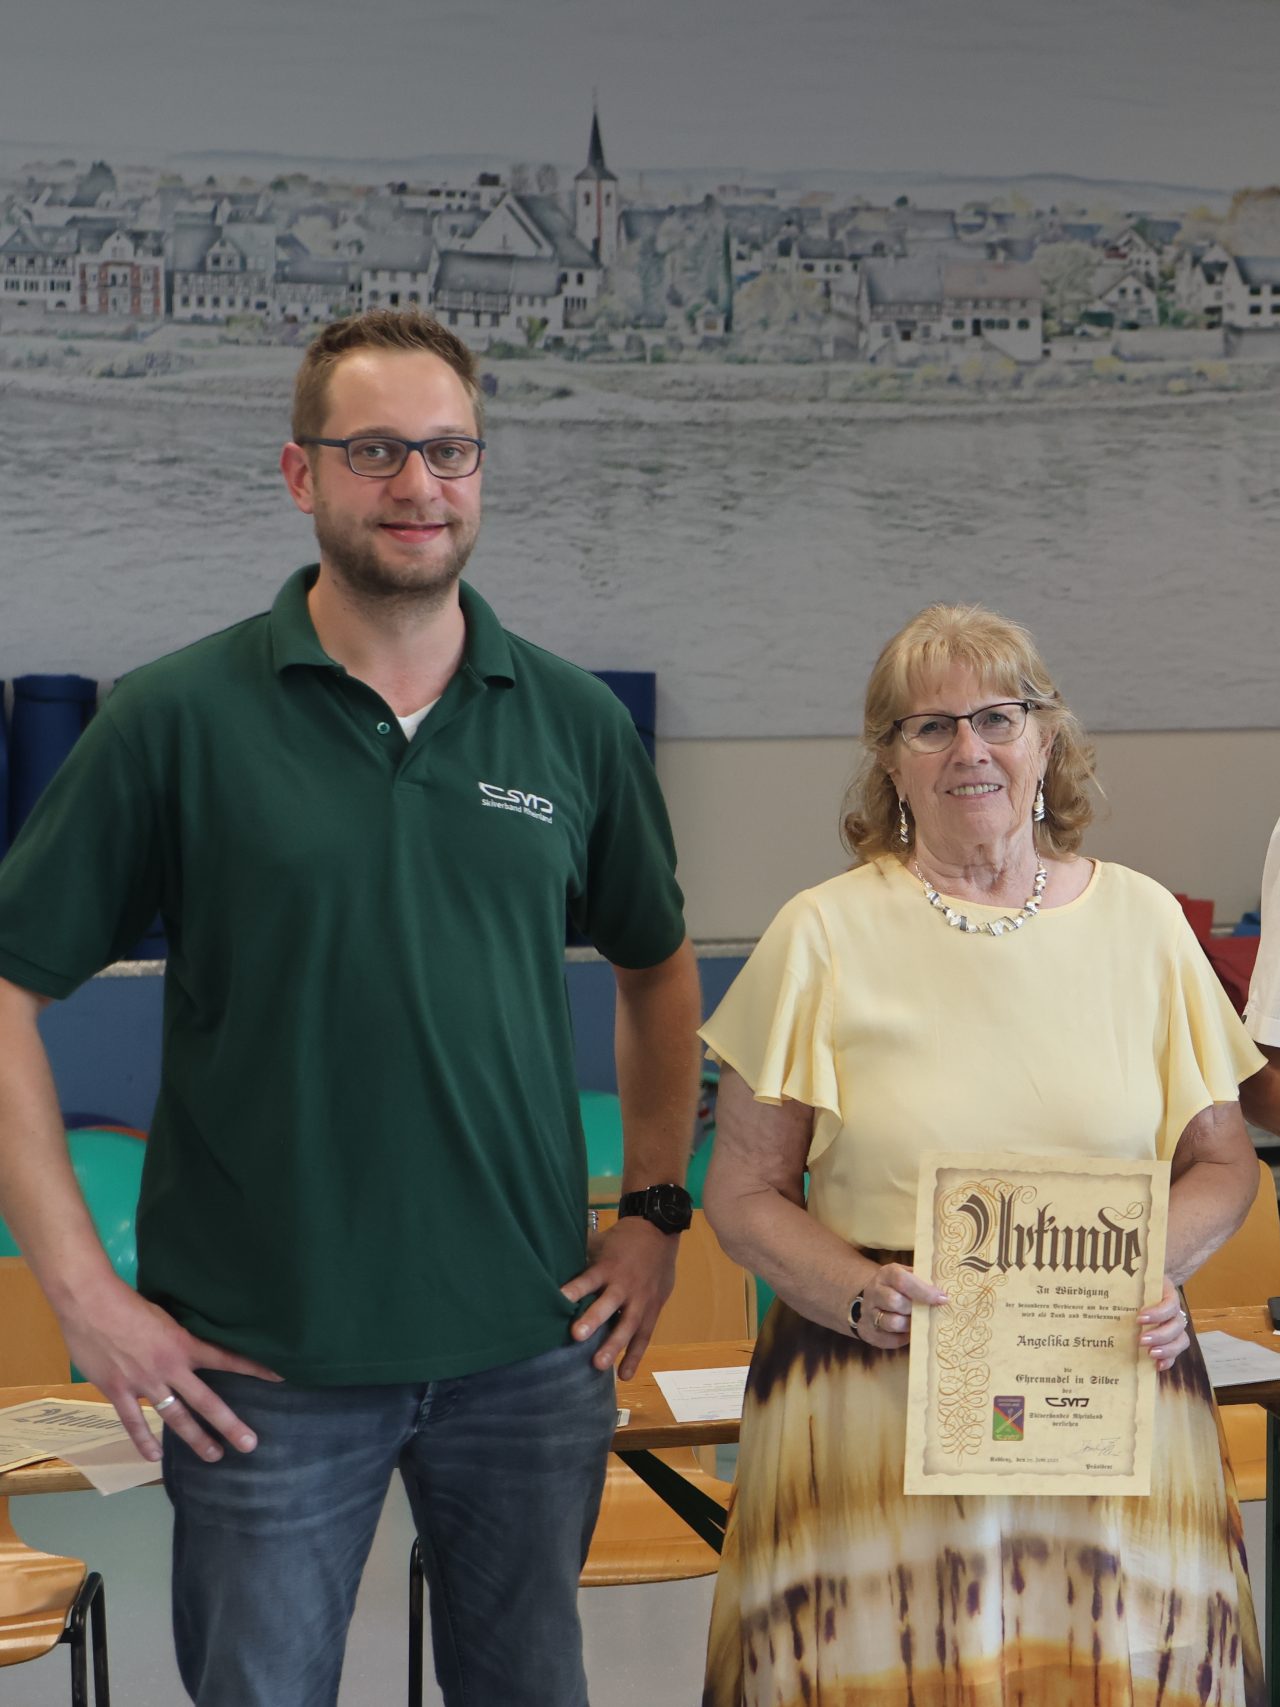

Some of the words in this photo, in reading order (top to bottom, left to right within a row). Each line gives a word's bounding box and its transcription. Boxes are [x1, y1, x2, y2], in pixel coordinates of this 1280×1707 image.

[956, 1187, 1143, 1277] Urkunde
[1055, 1286, 1109, 1299] Würdigung
[1016, 1334, 1070, 1349] Angelika
[1072, 1335, 1115, 1348] Strunk
[1015, 1374, 1070, 1385] Ehrennadel
[1075, 1375, 1084, 1384] in
[1089, 1375, 1120, 1385] Silber
